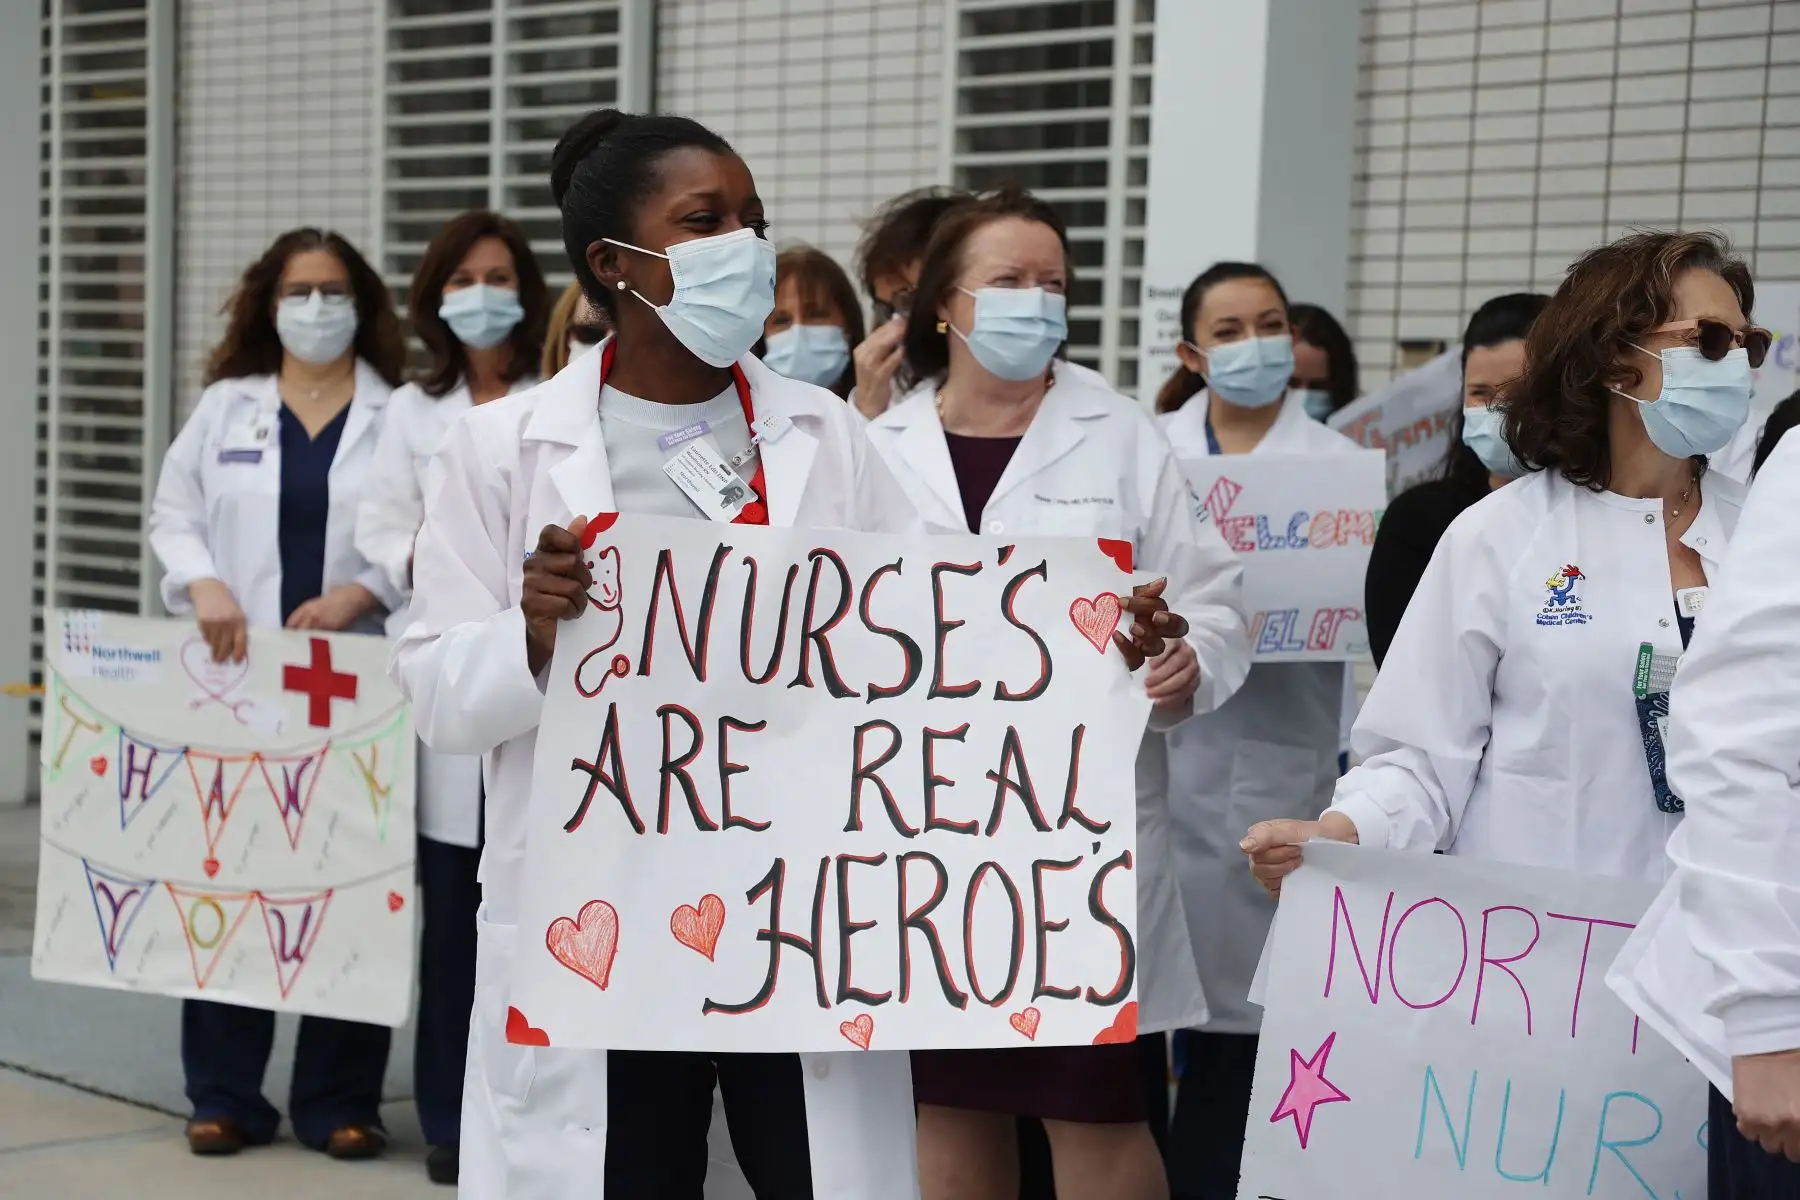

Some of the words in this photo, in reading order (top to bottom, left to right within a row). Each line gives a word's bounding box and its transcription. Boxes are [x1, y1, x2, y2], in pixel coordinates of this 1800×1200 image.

[1203, 475, 1384, 552] ELCOM
[91, 645, 161, 662] Northwell
[636, 542, 1053, 703] NURSE'S
[562, 702, 772, 834] ARE
[843, 718, 1111, 838] REAL
[702, 841, 1137, 1016] HEROE'S
[1322, 885, 1640, 1055] NORT
[1413, 1064, 1708, 1200] NUR
